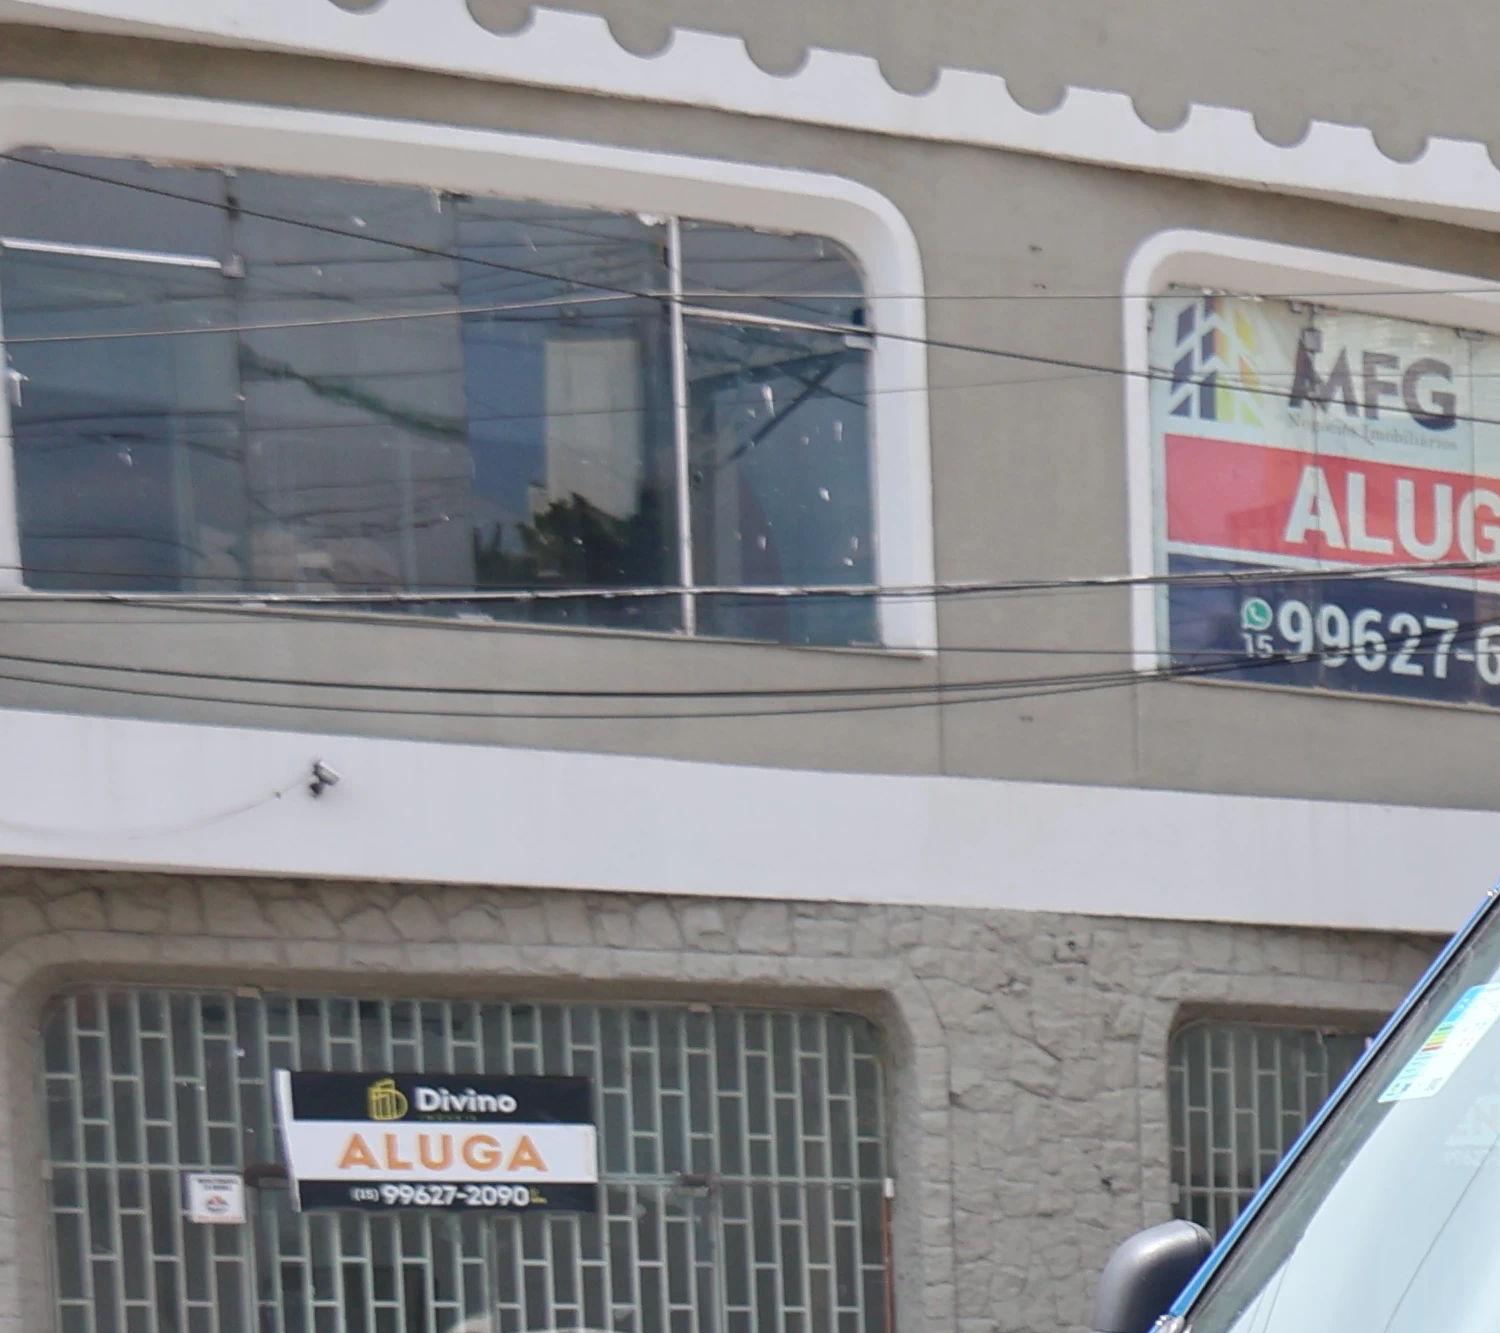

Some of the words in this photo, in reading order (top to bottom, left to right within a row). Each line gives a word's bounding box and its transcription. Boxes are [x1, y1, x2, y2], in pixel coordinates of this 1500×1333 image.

[1287, 340, 1458, 431] MFG
[1244, 634, 1273, 658] 15
[415, 1087, 517, 1113] Divino
[338, 1133, 549, 1172] ALUGA
[353, 1186, 380, 1201] (15)
[382, 1184, 530, 1206] 99627-2090
